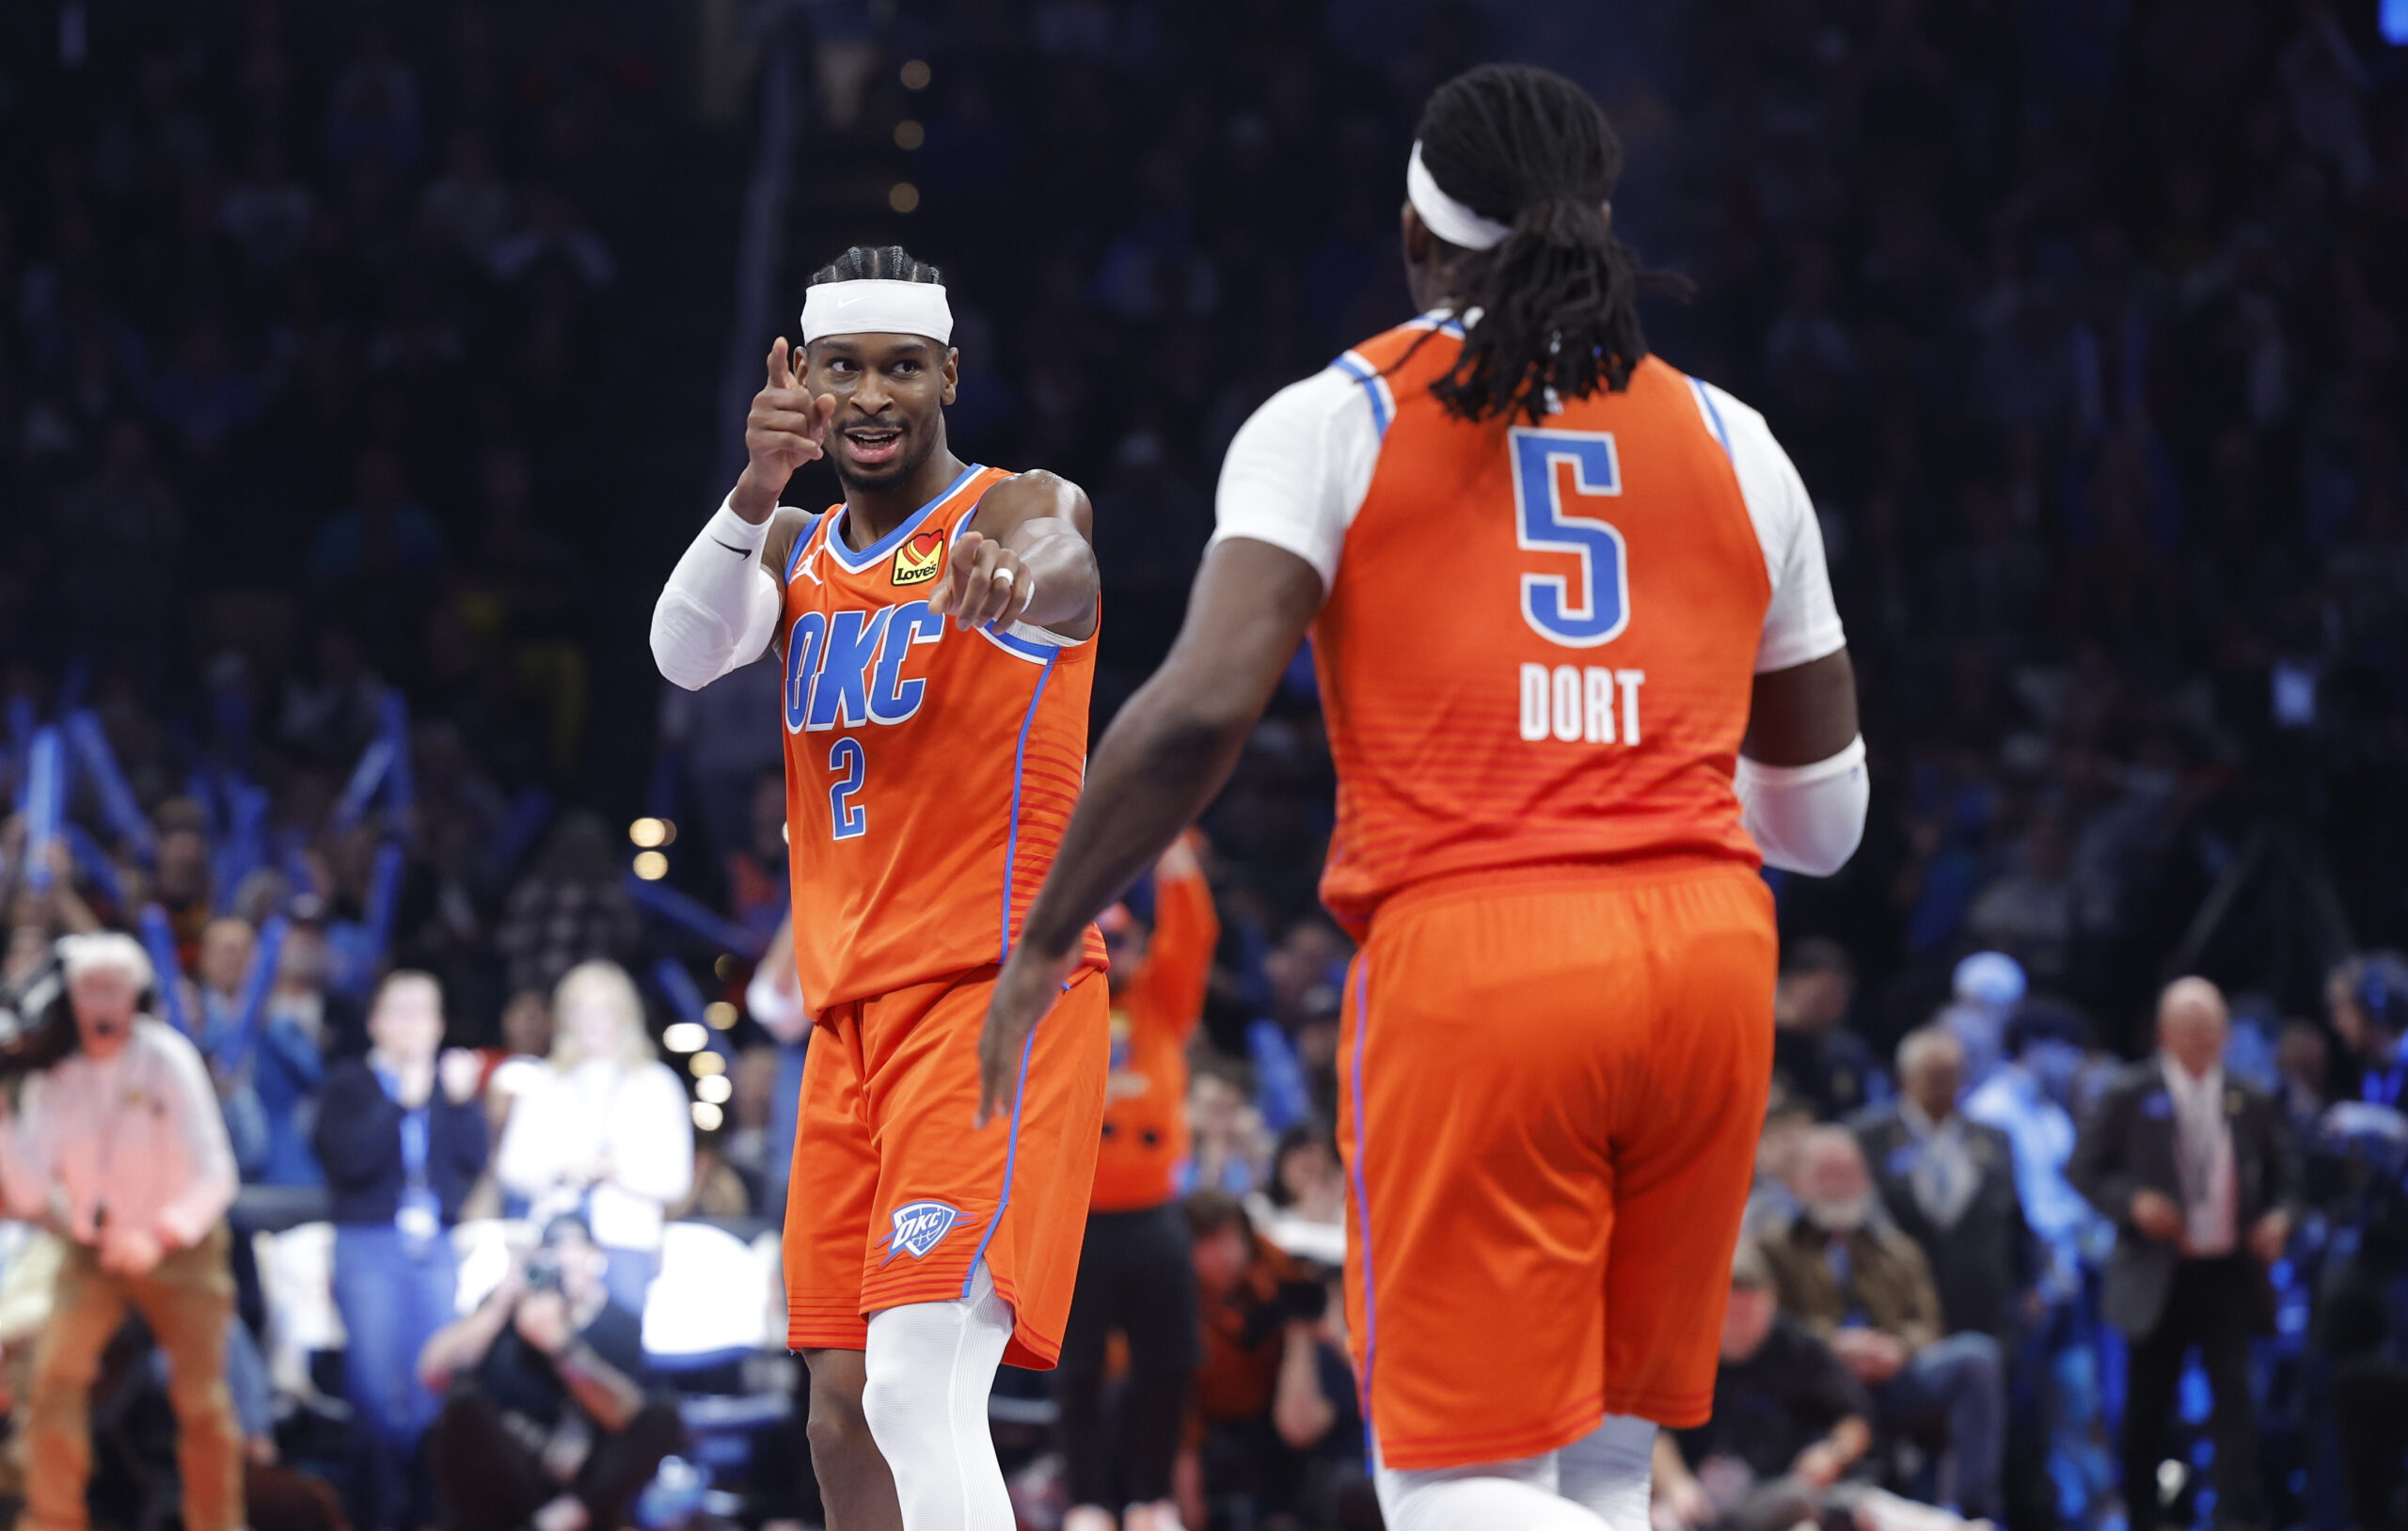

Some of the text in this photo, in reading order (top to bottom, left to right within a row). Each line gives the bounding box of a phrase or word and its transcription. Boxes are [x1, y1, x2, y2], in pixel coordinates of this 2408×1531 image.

[1508, 425, 1631, 649] 5
[784, 600, 945, 735] OKC
[1518, 662, 1645, 746] DORT
[829, 736, 866, 841] 2
[892, 1210, 942, 1250] OKC
